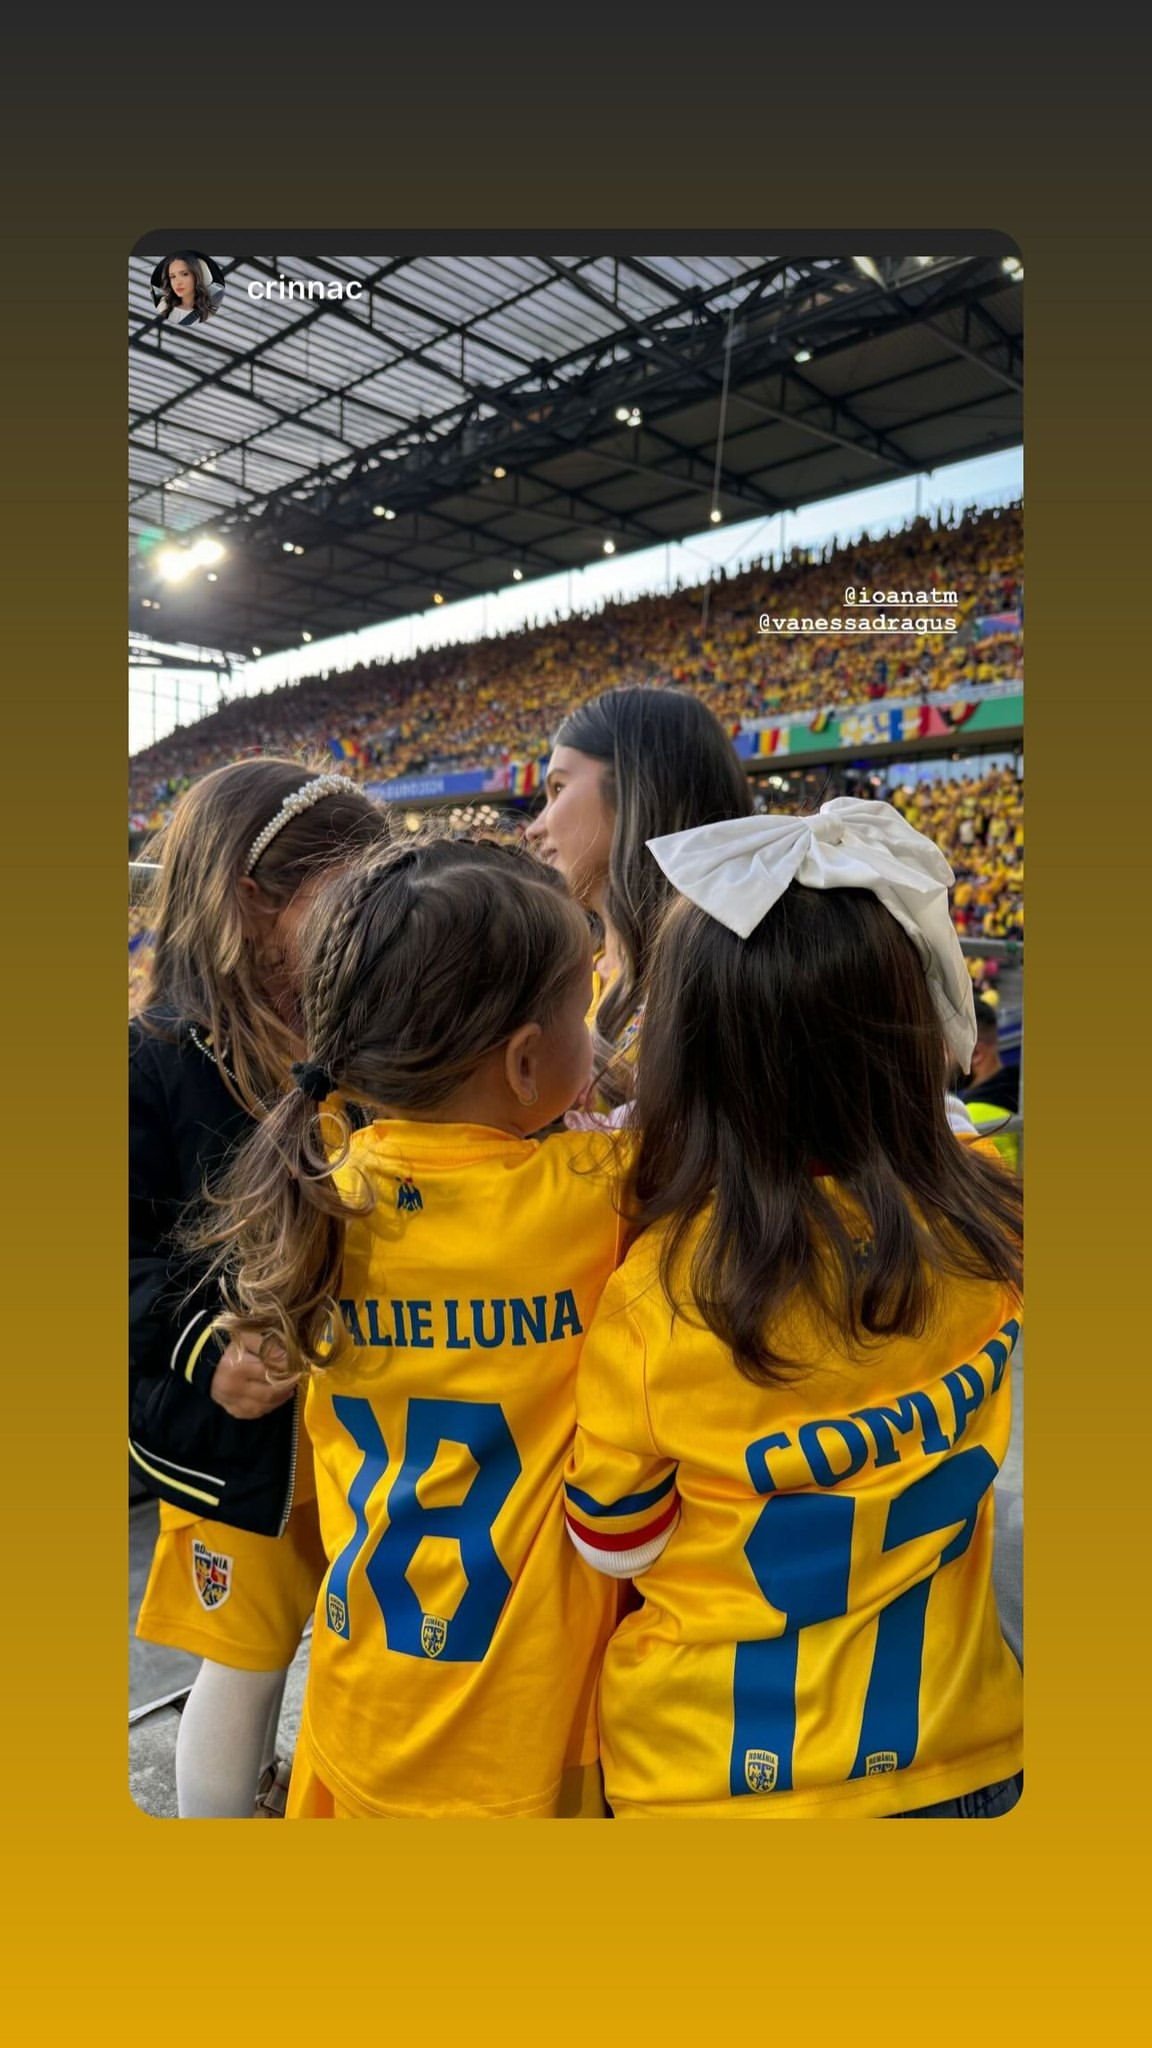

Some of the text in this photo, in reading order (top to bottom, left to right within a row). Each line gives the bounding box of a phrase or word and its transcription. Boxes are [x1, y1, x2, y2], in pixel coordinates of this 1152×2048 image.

[320, 1289, 583, 1349] ALIE LUNA
[326, 1394, 523, 1662] 18
[730, 1444, 999, 1797] 17
